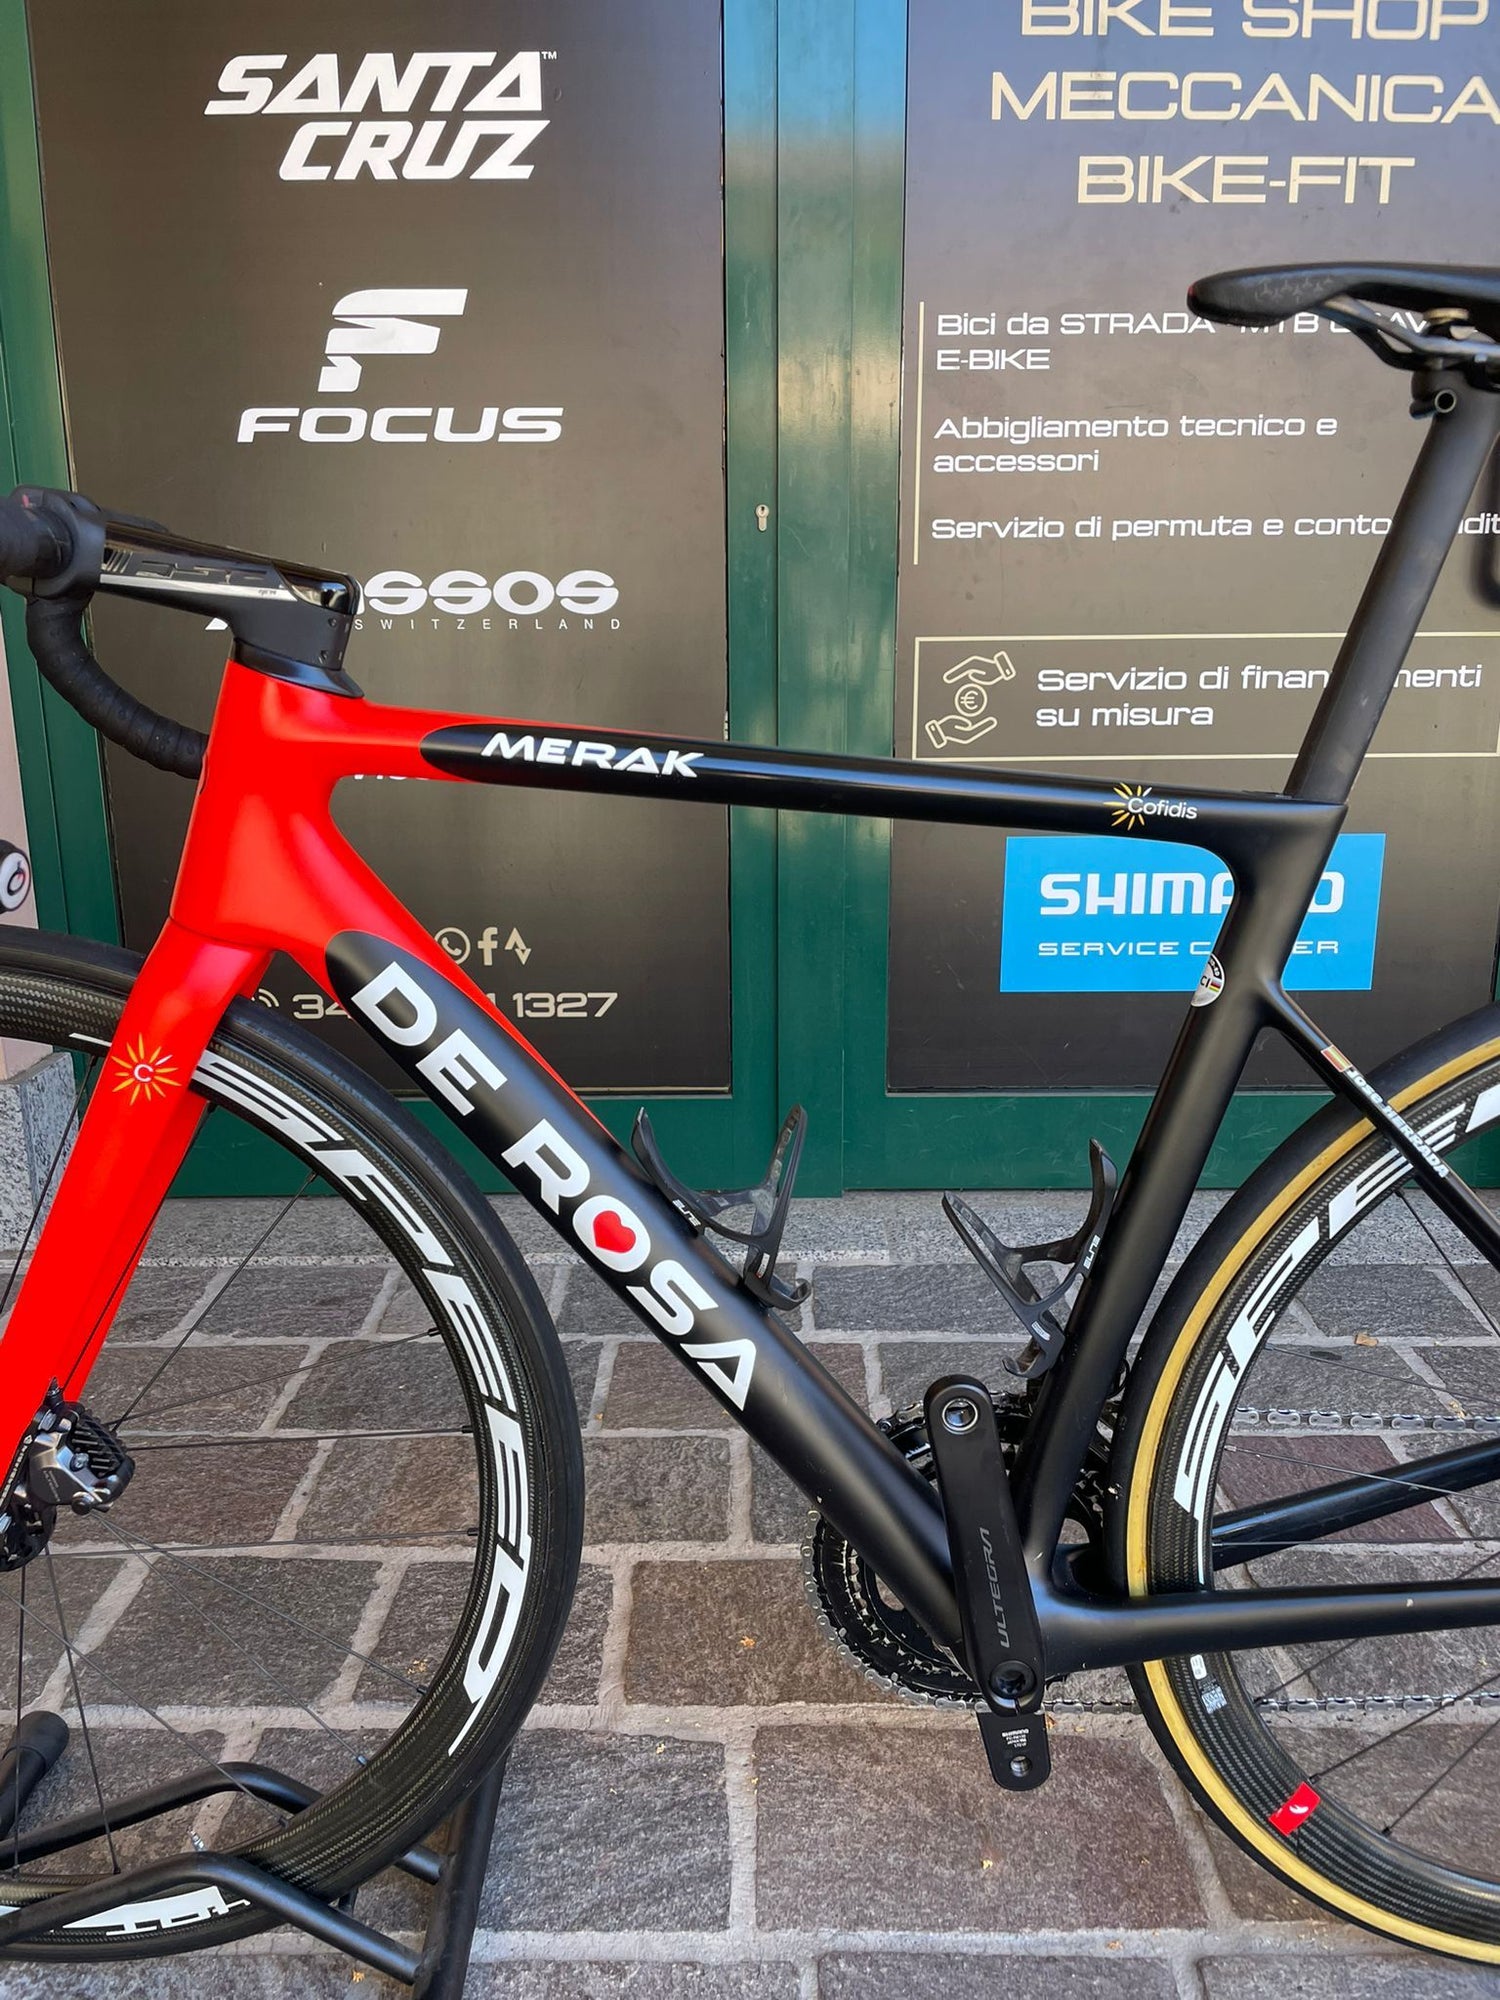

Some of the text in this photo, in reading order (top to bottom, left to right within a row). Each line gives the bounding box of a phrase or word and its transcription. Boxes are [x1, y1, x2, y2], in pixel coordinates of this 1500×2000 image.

[1021, 0, 1489, 41] BIKE SHOP
[204, 51, 546, 115] SANTA
[991, 71, 1500, 125] MECCANICA
[279, 119, 550, 181] CRUZ
[1077, 155, 1416, 204] BIKE-FIT
[937, 312, 996, 336] Bici
[1006, 312, 1049, 335] da
[1060, 312, 1216, 335] STRADA
[936, 348, 1051, 371] E-BIKE
[237, 407, 564, 443] FOCUS
[933, 413, 1338, 445] Abbigliamento tecnico e
[933, 449, 1099, 473] accessori
[931, 515, 1392, 541] Servizio di permuta e conto
[356, 570, 619, 616] SSOS
[354, 618, 621, 630] SWITZERLAND
[1037, 666, 1187, 691] Servizio
[1199, 665, 1230, 690] di
[1036, 702, 1214, 727] su misura
[479, 731, 705, 778] MERAK
[1127, 797, 1198, 819] Cofidis
[1040, 871, 1346, 914] SHIMAO
[1038, 941, 1339, 956] SERVICE CER
[512, 992, 618, 1018] 1327
[350, 960, 757, 1411] DE ROSA
[979, 1526, 1011, 1649] ULTEGRA
